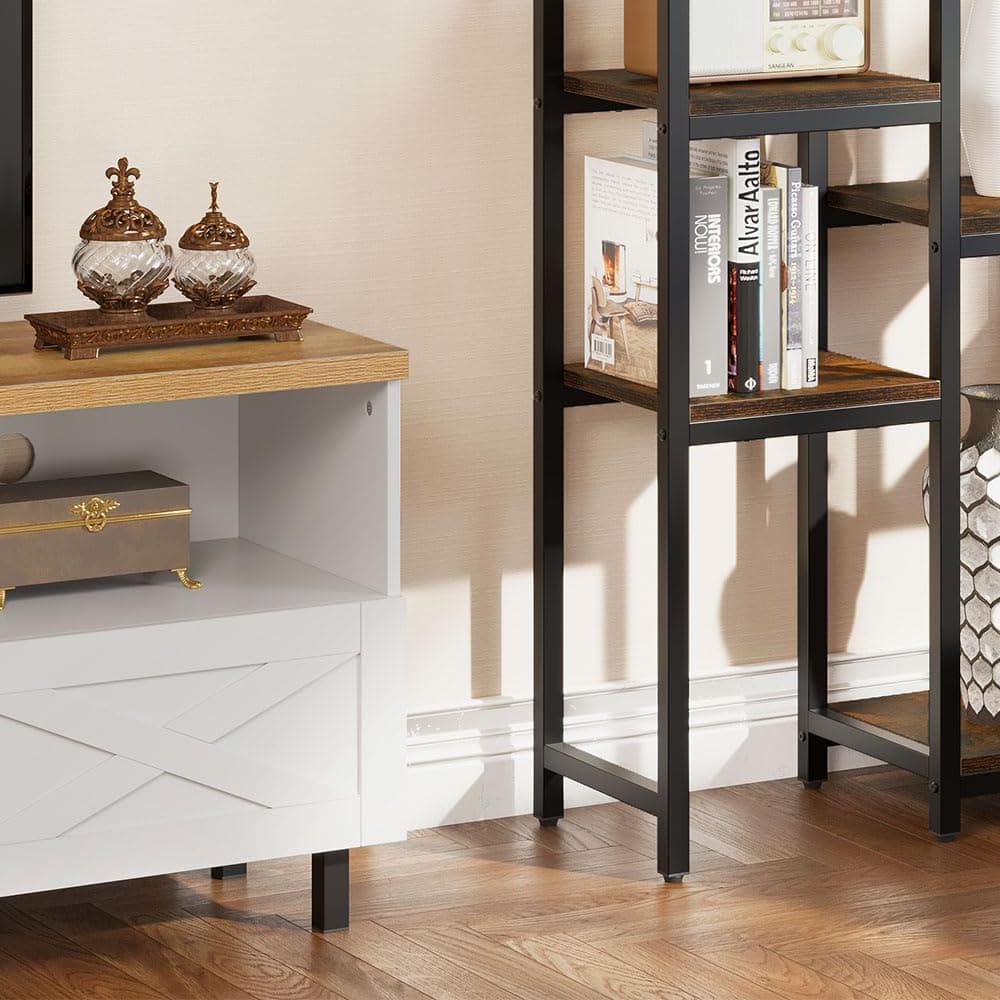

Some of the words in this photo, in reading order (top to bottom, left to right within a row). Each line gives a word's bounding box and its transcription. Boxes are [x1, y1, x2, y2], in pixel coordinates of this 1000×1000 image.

[738, 149, 760, 202] Aalto
[790, 181, 802, 218] Picasso
[707, 213, 721, 284] INTERIORS
[738, 205, 760, 257] Alvar
[789, 219, 802, 259] Guitars
[704, 359, 712, 375] 1
